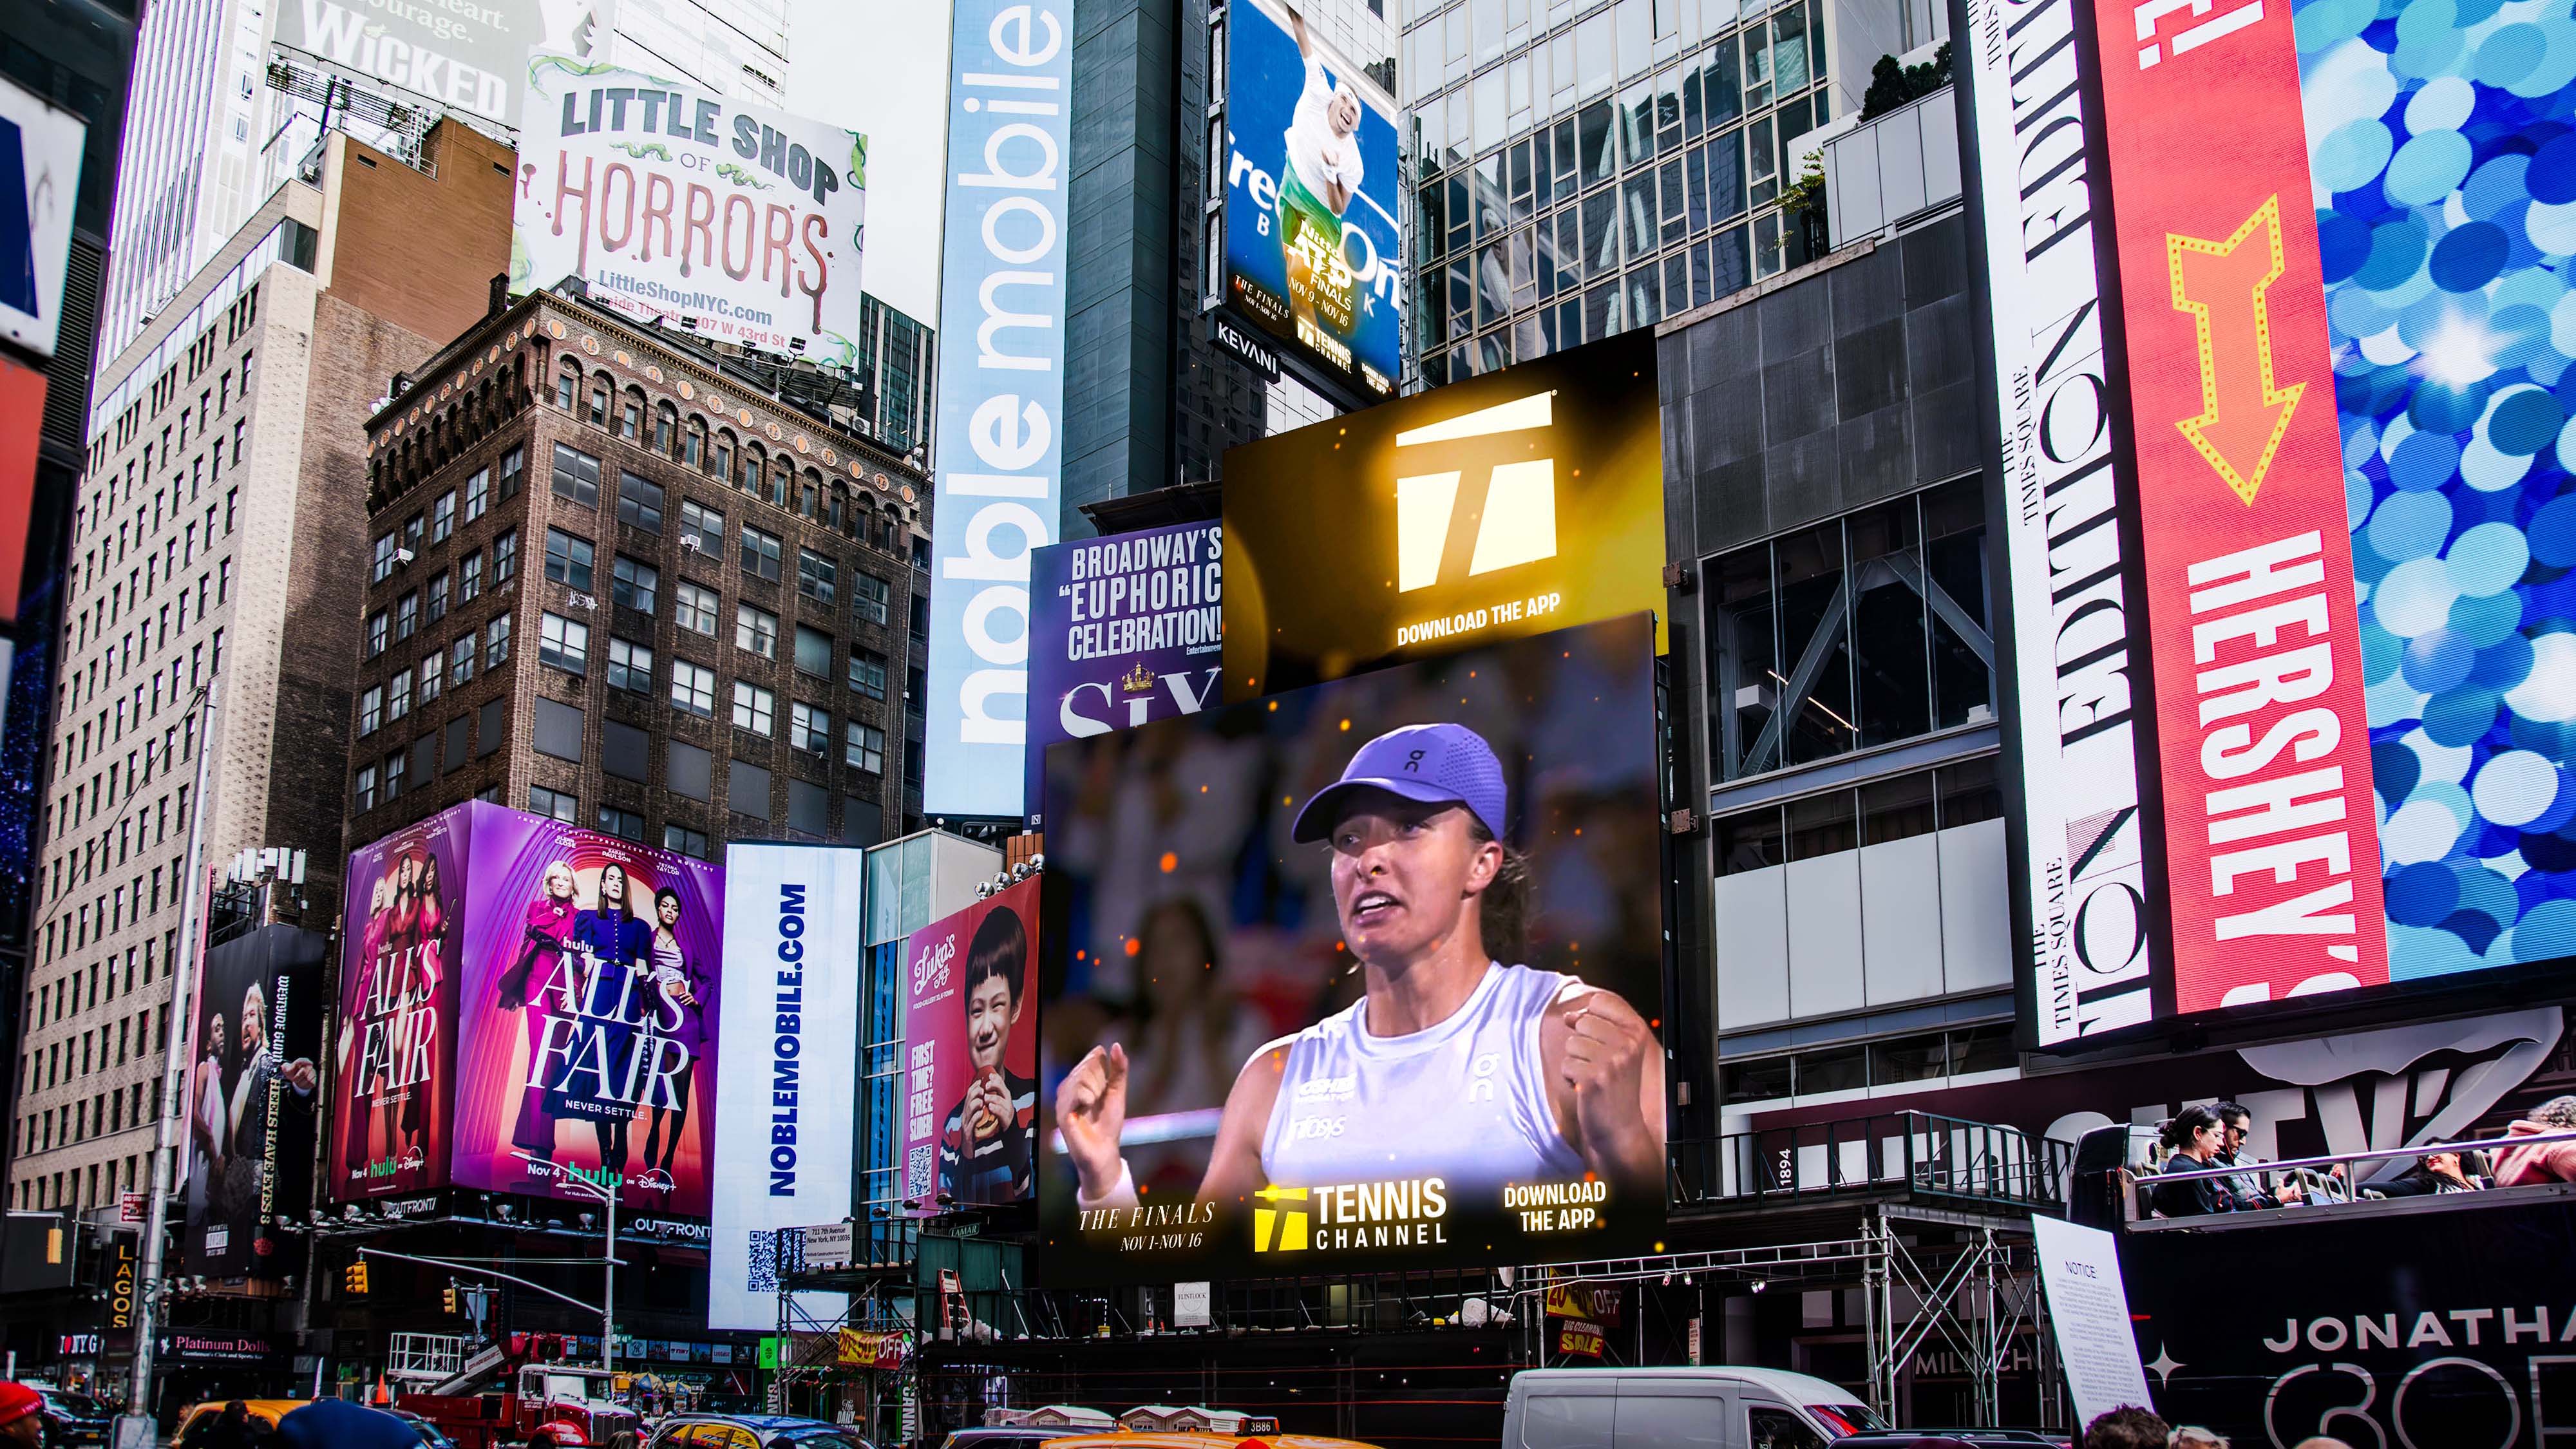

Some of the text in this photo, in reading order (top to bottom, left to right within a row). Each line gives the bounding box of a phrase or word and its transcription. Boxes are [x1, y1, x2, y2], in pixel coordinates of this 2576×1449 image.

[367, 0, 474, 43] ourage.
[562, 88, 838, 206] LITTLE SHOP
[680, 153, 712, 172] OF
[958, 3, 1063, 372] mobile
[551, 149, 829, 335] HORRORS
[1300, 220, 1340, 260] Nitto
[600, 269, 773, 326] LittleShopNYC.com
[1235, 274, 1290, 319] THE FINALS
[1289, 277, 1309, 298] NOV
[1307, 289, 1316, 303] 9
[1320, 300, 1340, 320] NOV
[1338, 311, 1349, 327] 16
[1310, 273, 1352, 312] FINALS
[722, 323, 734, 335] W
[737, 327, 768, 344] 43rd
[772, 334, 786, 348] St
[1218, 323, 1277, 375] KEVANI
[1315, 327, 1352, 364] TENNIS
[1315, 344, 1352, 375] CHANNEL
[2013, 365, 2038, 526] TIMES SQUARE
[1072, 526, 1222, 580] BROADWAY’S
[943, 393, 1052, 744] noble
[1067, 606, 1222, 661] CELEBRATION!
[1396, 592, 1561, 647] DOWNLOAD THE APP
[517, 815, 714, 873] FROM EXECUTIVE PRODUCER RYAN MURPHY
[554, 839, 576, 849] CLOSE
[601, 850, 631, 863] PAULSON
[656, 866, 680, 876] TAYLOR
[563, 936, 594, 954] hulu
[2047, 857, 2072, 1029] TIMES SQUARE
[354, 1007, 438, 1099] FAIR
[770, 884, 806, 1197] NOBLEMOBILE.COM
[911, 1040, 935, 1070] FIRST
[526, 1014, 689, 1112] FAIR
[911, 1063, 934, 1091] TIME?
[565, 1099, 648, 1121] NEVER SETTLE.
[911, 1088, 933, 1117] FREE
[909, 1113, 933, 1142] SLIDER!
[370, 1155, 397, 1179] hulu
[527, 1164, 551, 1178] Nov
[553, 1167, 560, 1178] 4
[568, 1161, 623, 1188] hulu
[1779, 1149, 1792, 1186] 1894
[1312, 1177, 1447, 1224] TENNIS
[1504, 1181, 1607, 1208] DOWNLOAD
[951, 1225, 977, 1237] LAMAR
[1079, 1201, 1216, 1231] THE FINALS
[1520, 1208, 1596, 1232] THE APP
[1120, 1235, 1148, 1252] NOV
[1188, 1232, 1203, 1248] 16
[1315, 1223, 1447, 1250] CHANNEL
[113, 1245, 133, 1329] LAGOS
[1563, 1320, 1574, 1331] BIG
[71, 1334, 88, 1354] NY
[176, 1335, 233, 1351] Platinum
[878, 1338, 902, 1360] OFF
[1561, 1333, 1603, 1354] SALE
[837, 1410, 856, 1425] DAILY
[842, 1398, 855, 1411] The
[1250, 1421, 1271, 1432] 3B86
